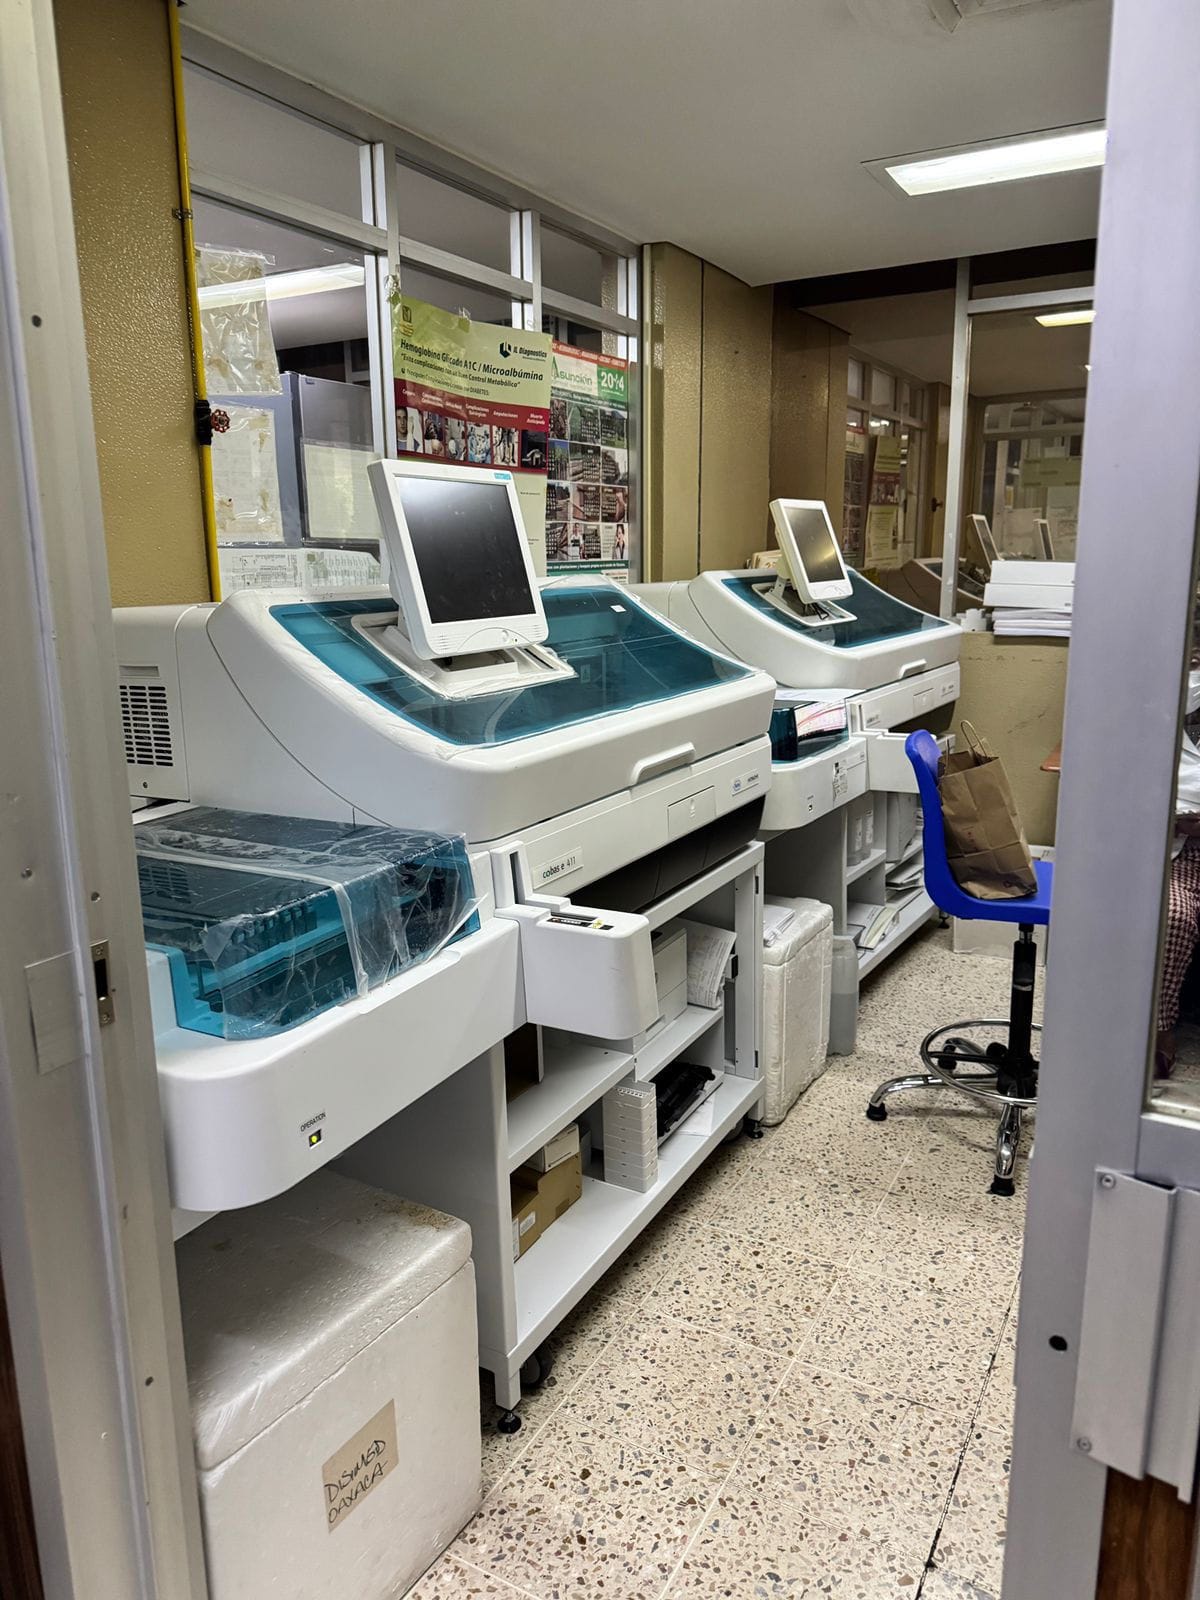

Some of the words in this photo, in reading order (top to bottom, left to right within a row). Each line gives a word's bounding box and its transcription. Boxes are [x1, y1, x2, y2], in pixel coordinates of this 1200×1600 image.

[400, 338, 440, 360] Hemoglobina
[464, 359, 477, 371] A1C
[482, 363, 544, 381] Microalbúmina
[519, 347, 548, 358] Diagnostics
[414, 358, 445, 372] complicaciones
[468, 374, 487, 383] Control
[600, 371, 625, 392] 2014
[542, 865, 561, 879] cobas
[566, 856, 576, 867] 411
[300, 1111, 326, 1132] OPERATION
[328, 1460, 388, 1524] OAXACA
